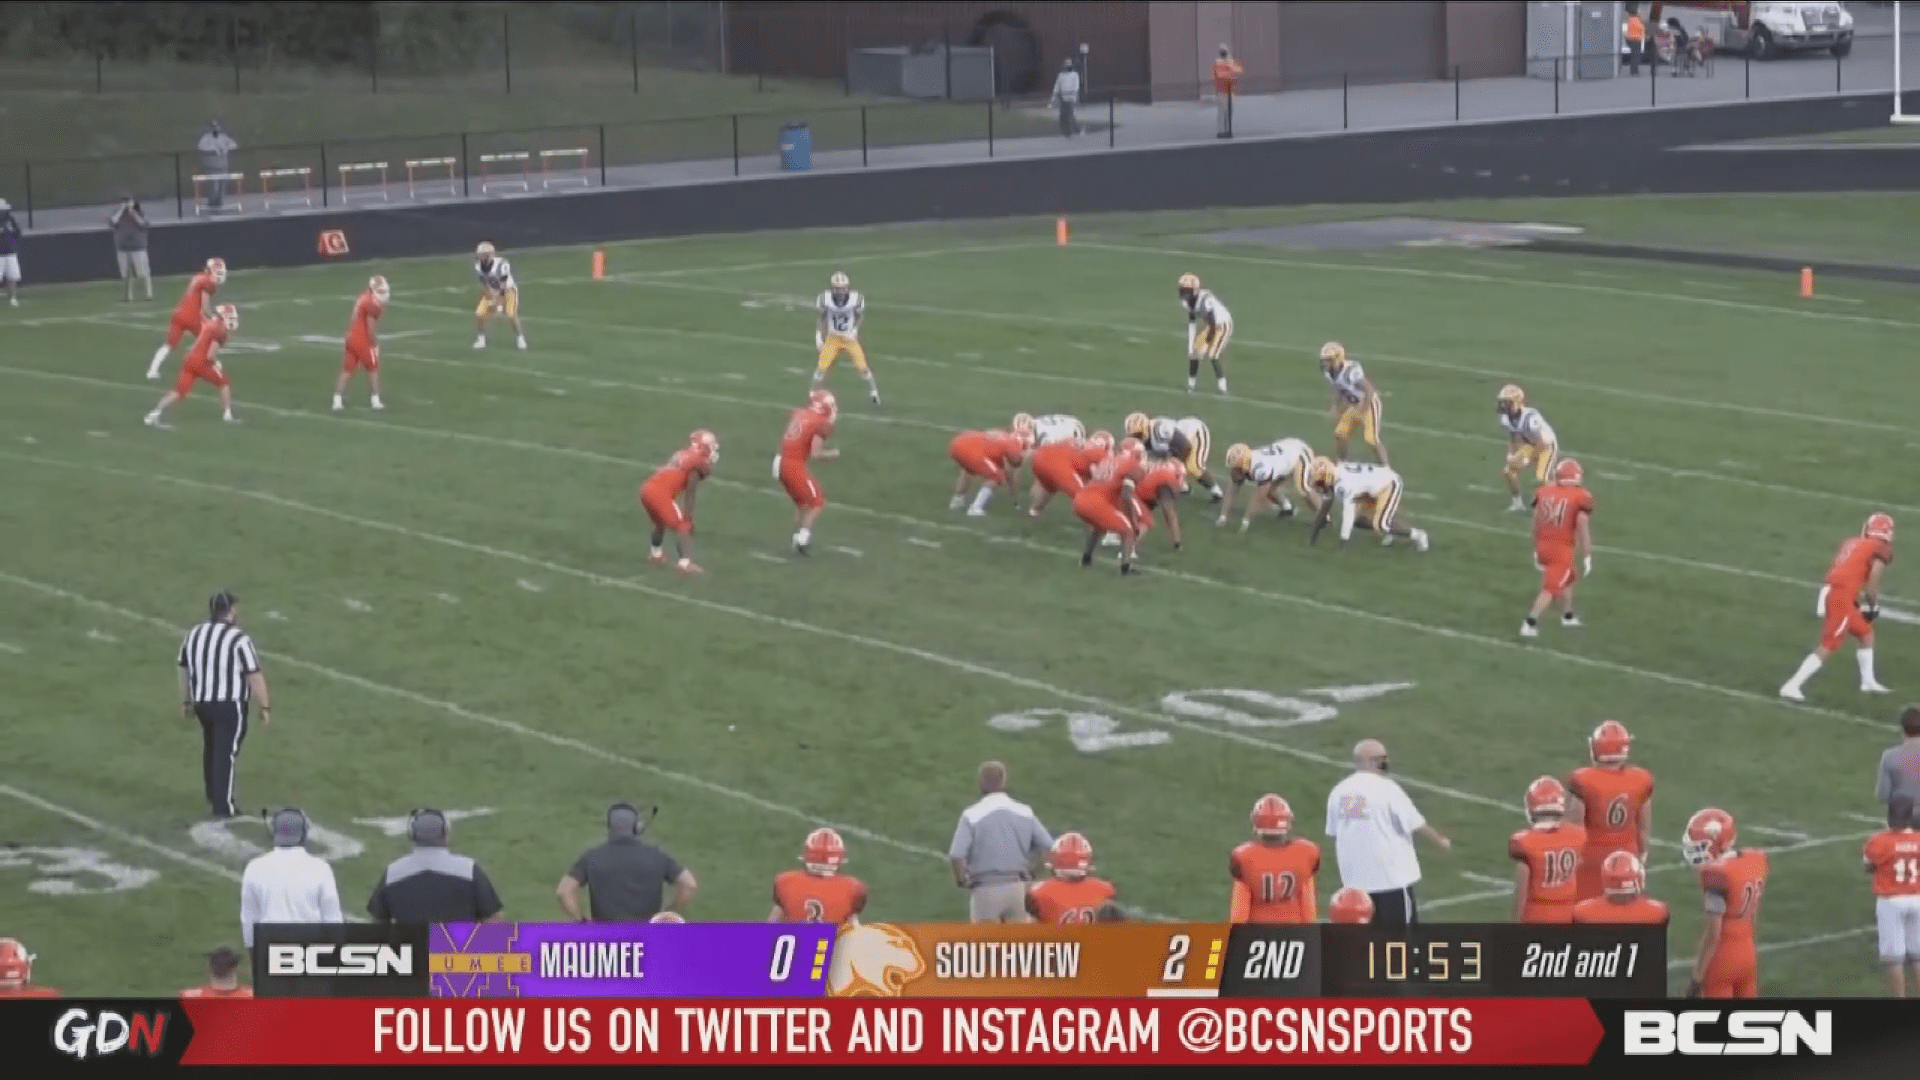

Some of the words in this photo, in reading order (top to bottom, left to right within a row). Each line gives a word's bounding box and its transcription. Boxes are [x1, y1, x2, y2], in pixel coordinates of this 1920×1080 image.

[987, 687, 1340, 753] 20
[1606, 793, 1629, 830] 6
[1262, 870, 1297, 903] 12
